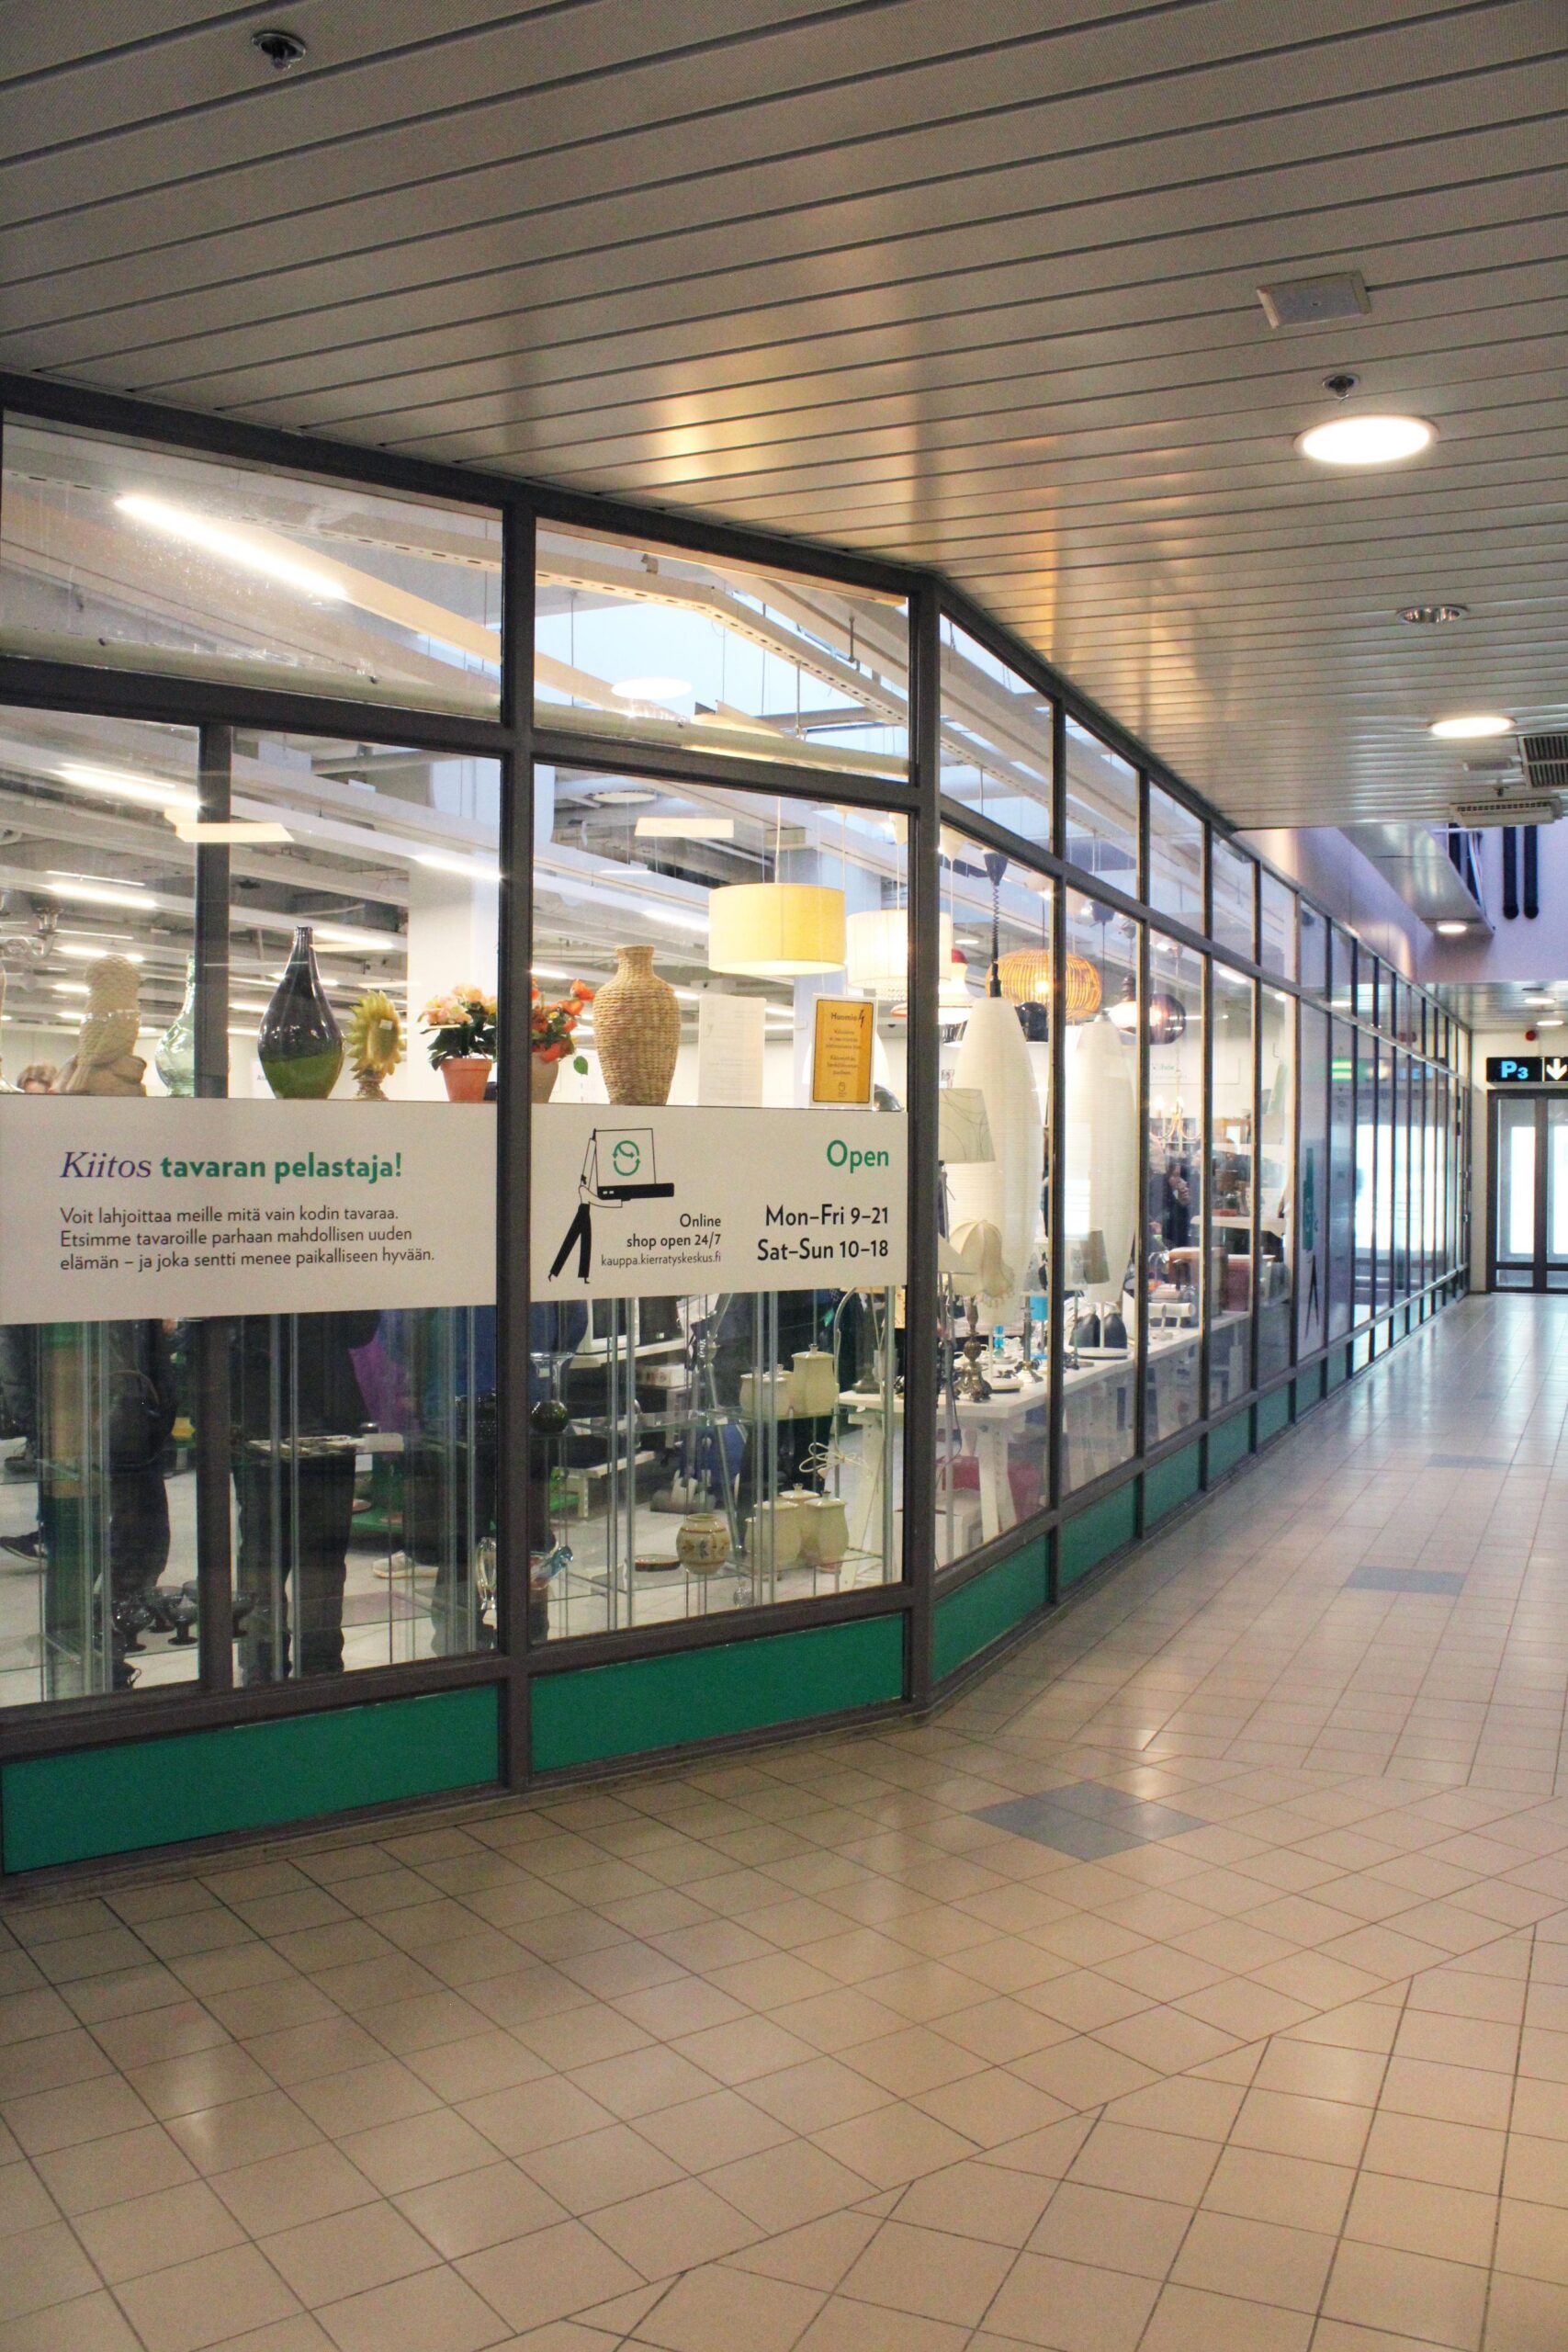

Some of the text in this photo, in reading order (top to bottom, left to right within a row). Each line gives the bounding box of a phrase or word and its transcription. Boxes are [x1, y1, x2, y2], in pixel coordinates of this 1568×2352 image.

[1501, 1060, 1529, 1080] P3
[60, 1151, 402, 1184] Kiitos tavaran pelastaja!
[827, 1139, 889, 1174] Open
[60, 1204, 399, 1227] Voit lahjoittaa meille mitä vain kodin tavaraa.
[679, 1213, 722, 1228] Online
[765, 1203, 888, 1227] Mon–Fri 9–21
[60, 1225, 412, 1248] Etsimme tavaroille parhaan mahdollisen uuden
[626, 1232, 721, 1250] shop open 24/7
[60, 1252, 119, 1271] elämän
[138, 1253, 152, 1272] ja
[156, 1250, 189, 1272] joka
[194, 1250, 236, 1267] sentti
[241, 1252, 291, 1266] menee
[296, 1247, 378, 1268] paikalliseen
[382, 1247, 434, 1266] hyvään.
[601, 1250, 721, 1269] kauppa.kierratyskeskus.fi
[757, 1237, 888, 1261] Sat–Sun 10–18
